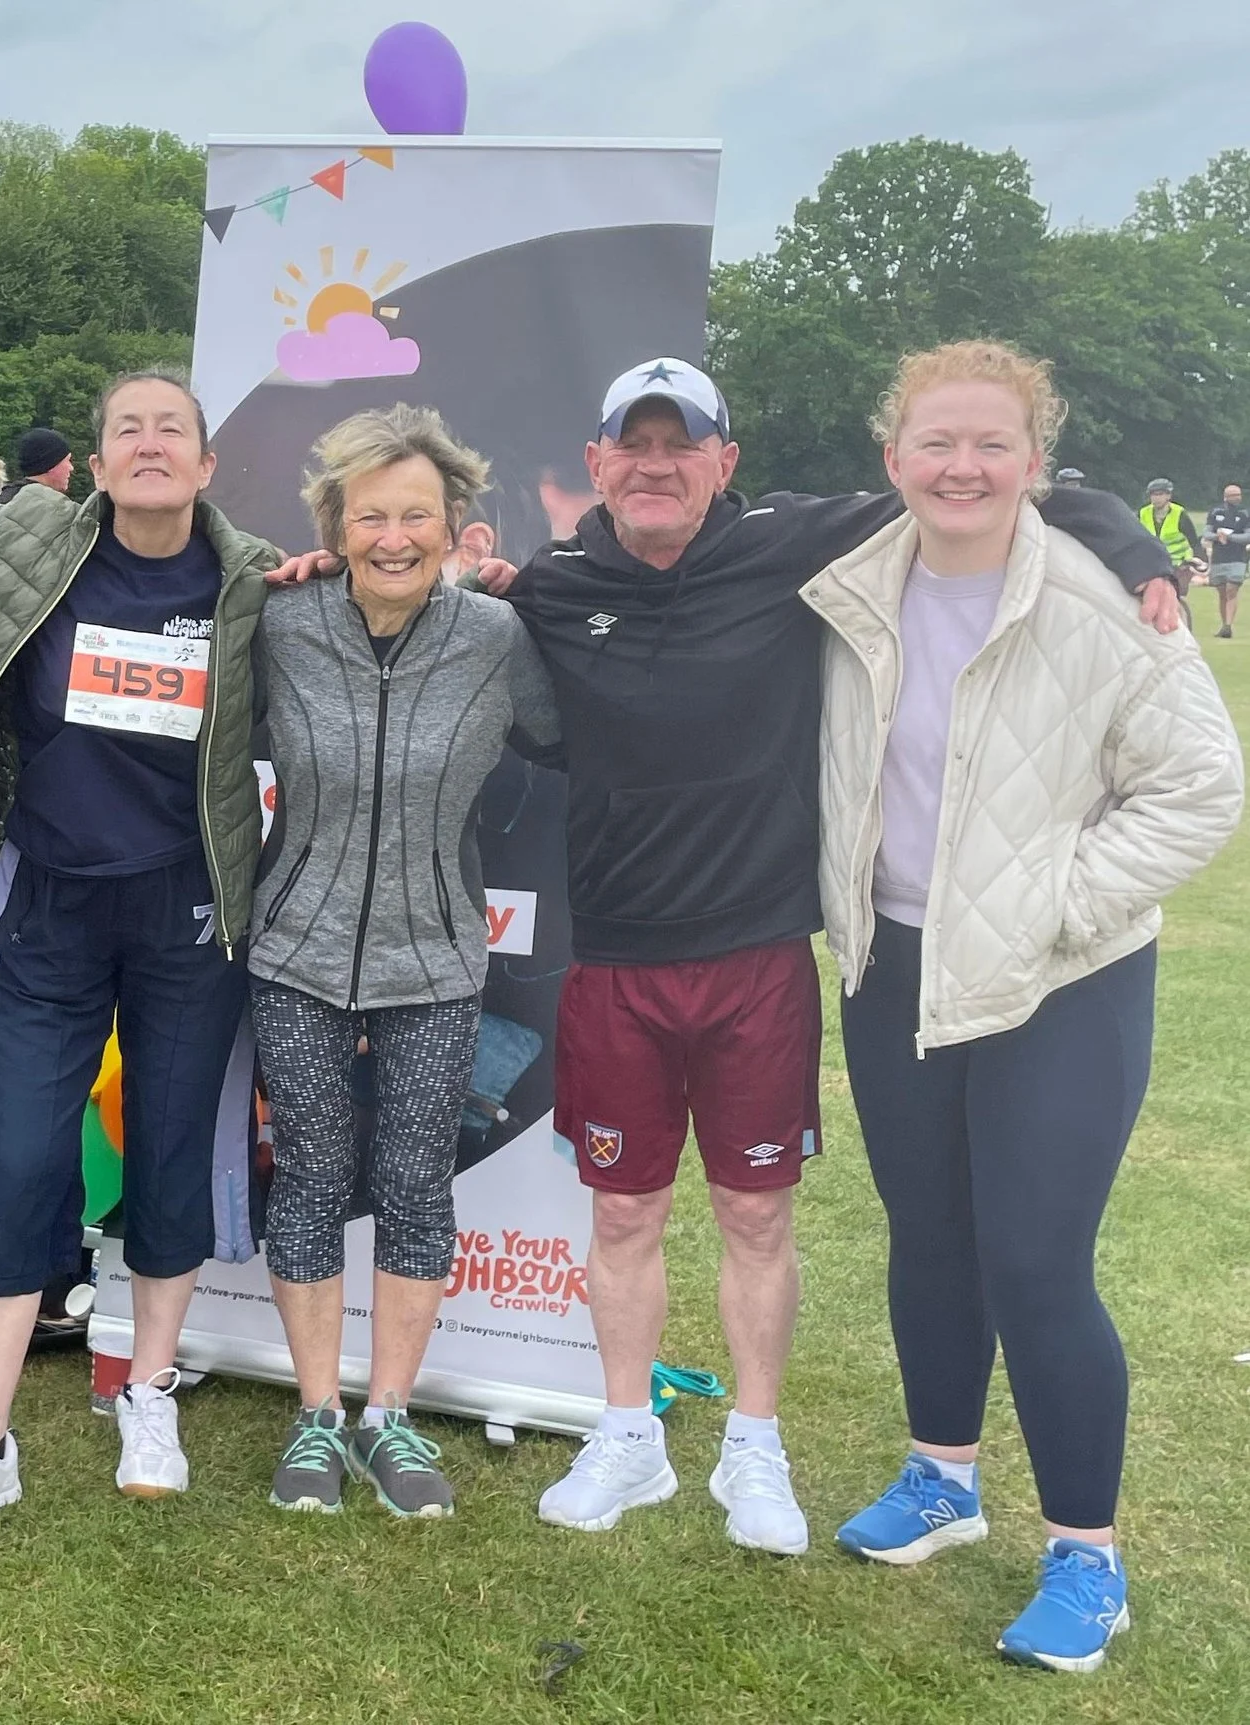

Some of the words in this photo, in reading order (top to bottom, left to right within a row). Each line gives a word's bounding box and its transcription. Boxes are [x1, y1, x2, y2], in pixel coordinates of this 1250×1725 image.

[93, 657, 184, 701] 459
[454, 1229, 494, 1255] ve
[194, 1285, 277, 1306] m/love-your-nei
[490, 1295, 570, 1317] Crawley
[461, 1323, 600, 1352] loveyourneighbourcrawle
